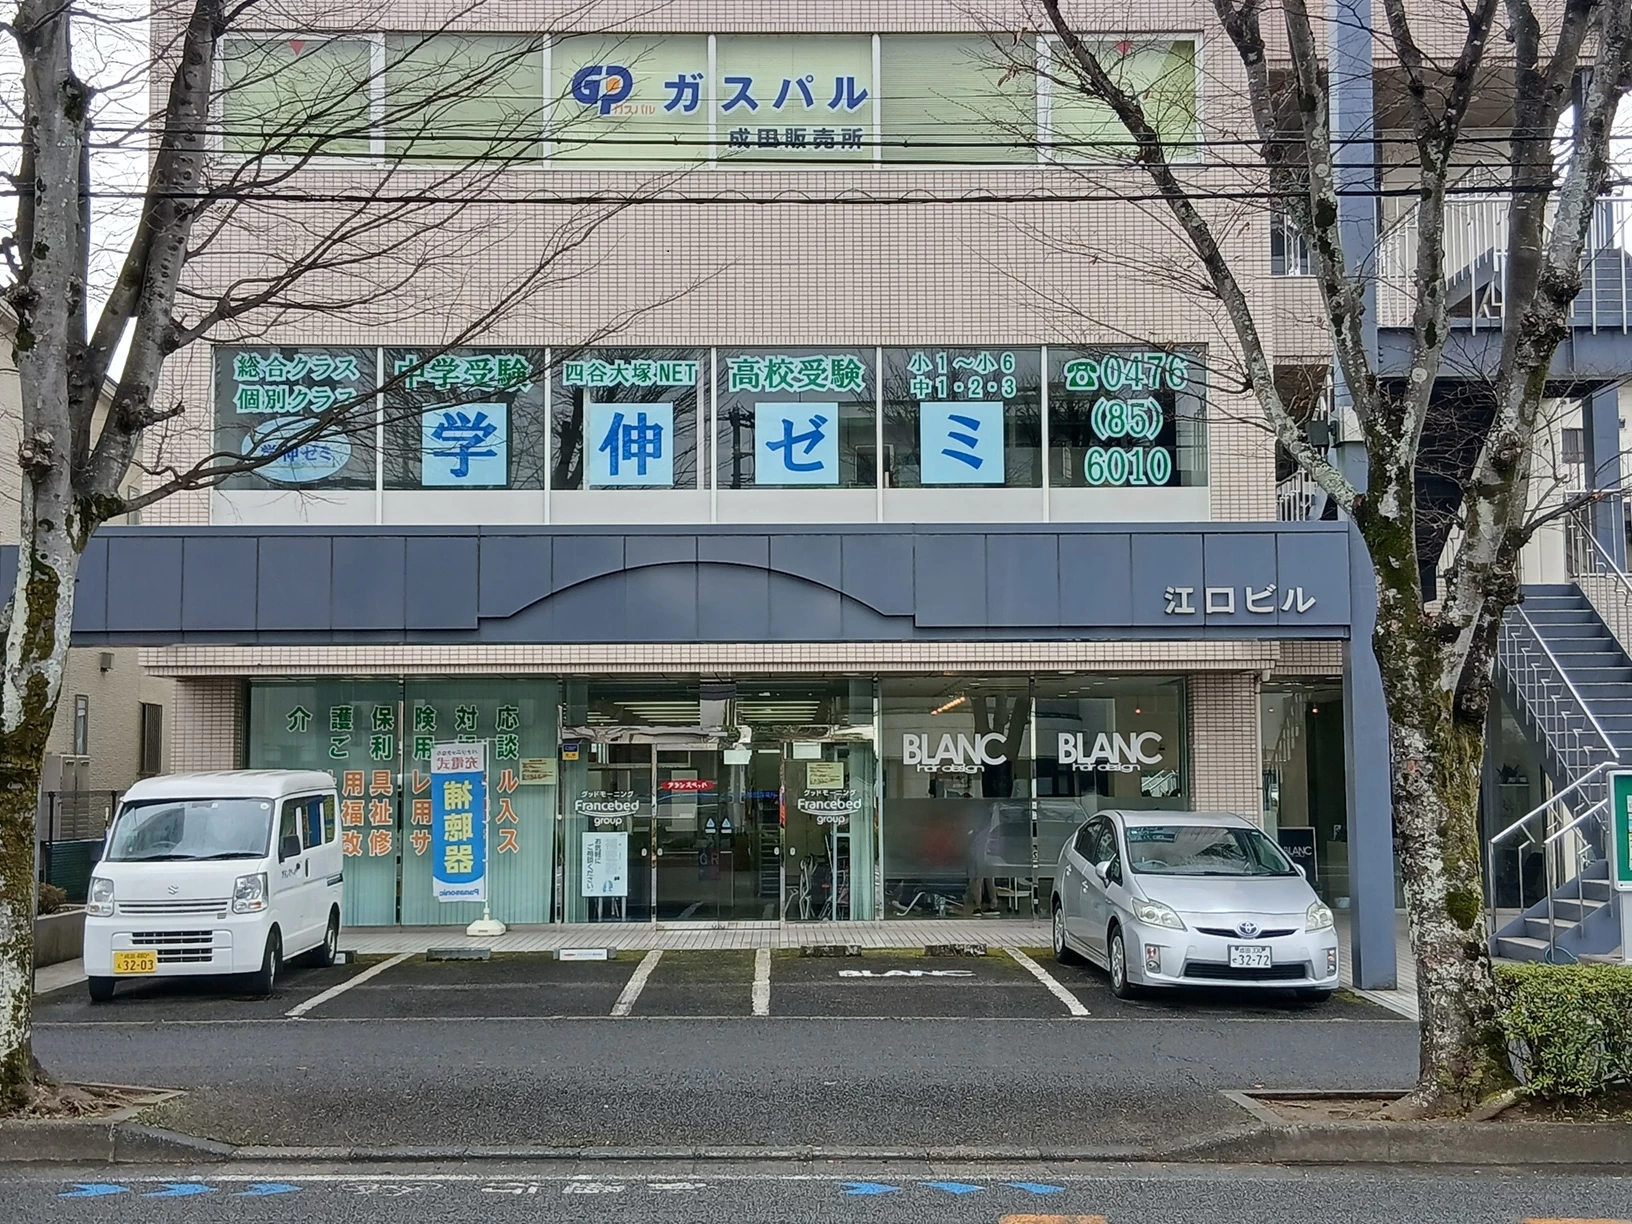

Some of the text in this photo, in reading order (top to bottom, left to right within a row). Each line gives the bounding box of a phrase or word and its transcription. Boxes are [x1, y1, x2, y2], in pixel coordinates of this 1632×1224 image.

[571, 65, 633, 115] GP
[663, 72, 869, 112] ガスパル
[612, 104, 656, 115] ガスパル
[729, 127, 863, 149] 成田販売所
[234, 353, 359, 380] 総合クラス
[396, 356, 533, 390] 中学受験
[728, 356, 865, 391] 高校受験
[1102, 353, 1189, 391] 0476
[1092, 397, 1163, 440] (85)
[1085, 447, 1171, 485] 6010
[1164, 583, 1317, 614] 江口ビル
[286, 704, 520, 733] 介護保険対応
[902, 732, 1007, 765] BLANC
[1058, 731, 1164, 764] BLANC
[575, 800, 640, 812] Francebed
[581, 790, 634, 798] グッドモーニング
[797, 798, 862, 810] Francebed
[803, 789, 857, 797] グッドモーニング
[593, 815, 623, 827] group
[816, 815, 846, 826] group
[123, 959, 154, 971] 32-03
[838, 969, 977, 978] BLANC
[1238, 954, 1270, 966] 32-72
